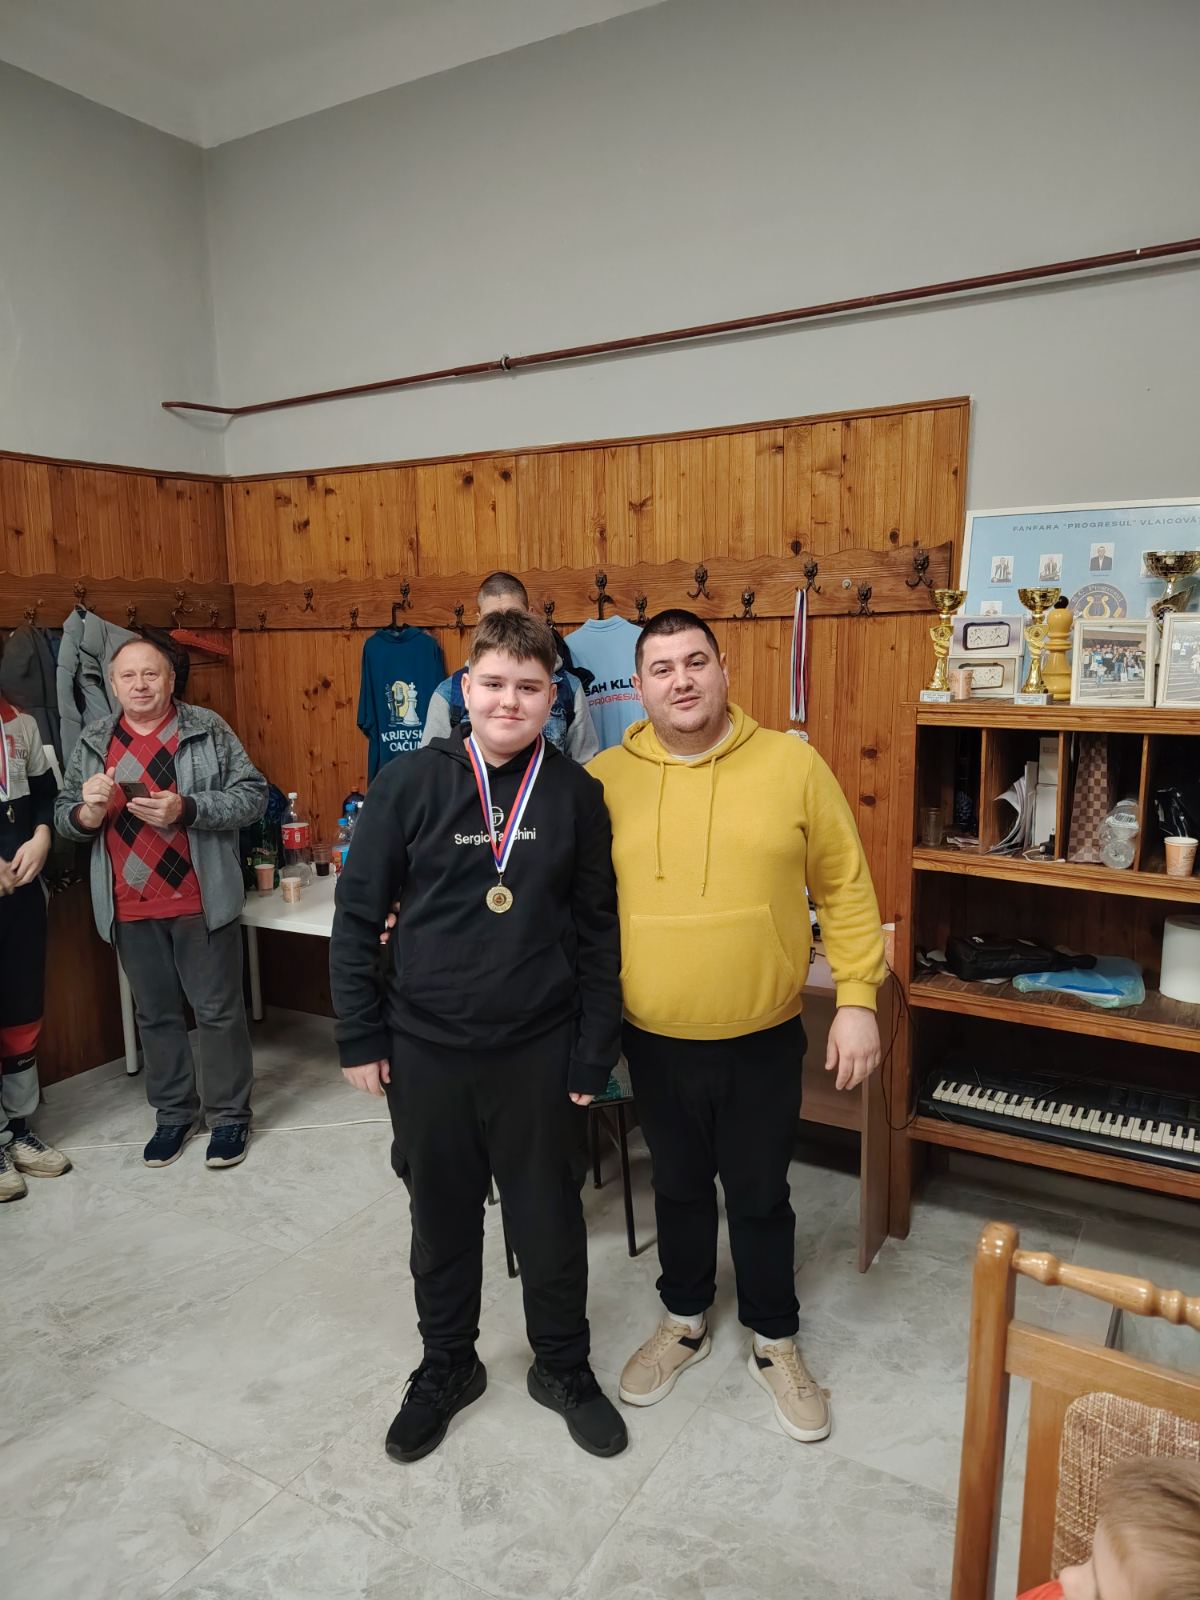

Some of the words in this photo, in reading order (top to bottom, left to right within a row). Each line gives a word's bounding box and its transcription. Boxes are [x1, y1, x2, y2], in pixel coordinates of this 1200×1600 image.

[1012, 524, 1060, 532] FANFARA
[1140, 516, 1200, 526] VLAICOVĂ
[610, 678, 634, 690] KLU
[454, 830, 491, 846] Sergio
[494, 827, 536, 842] Tahini
